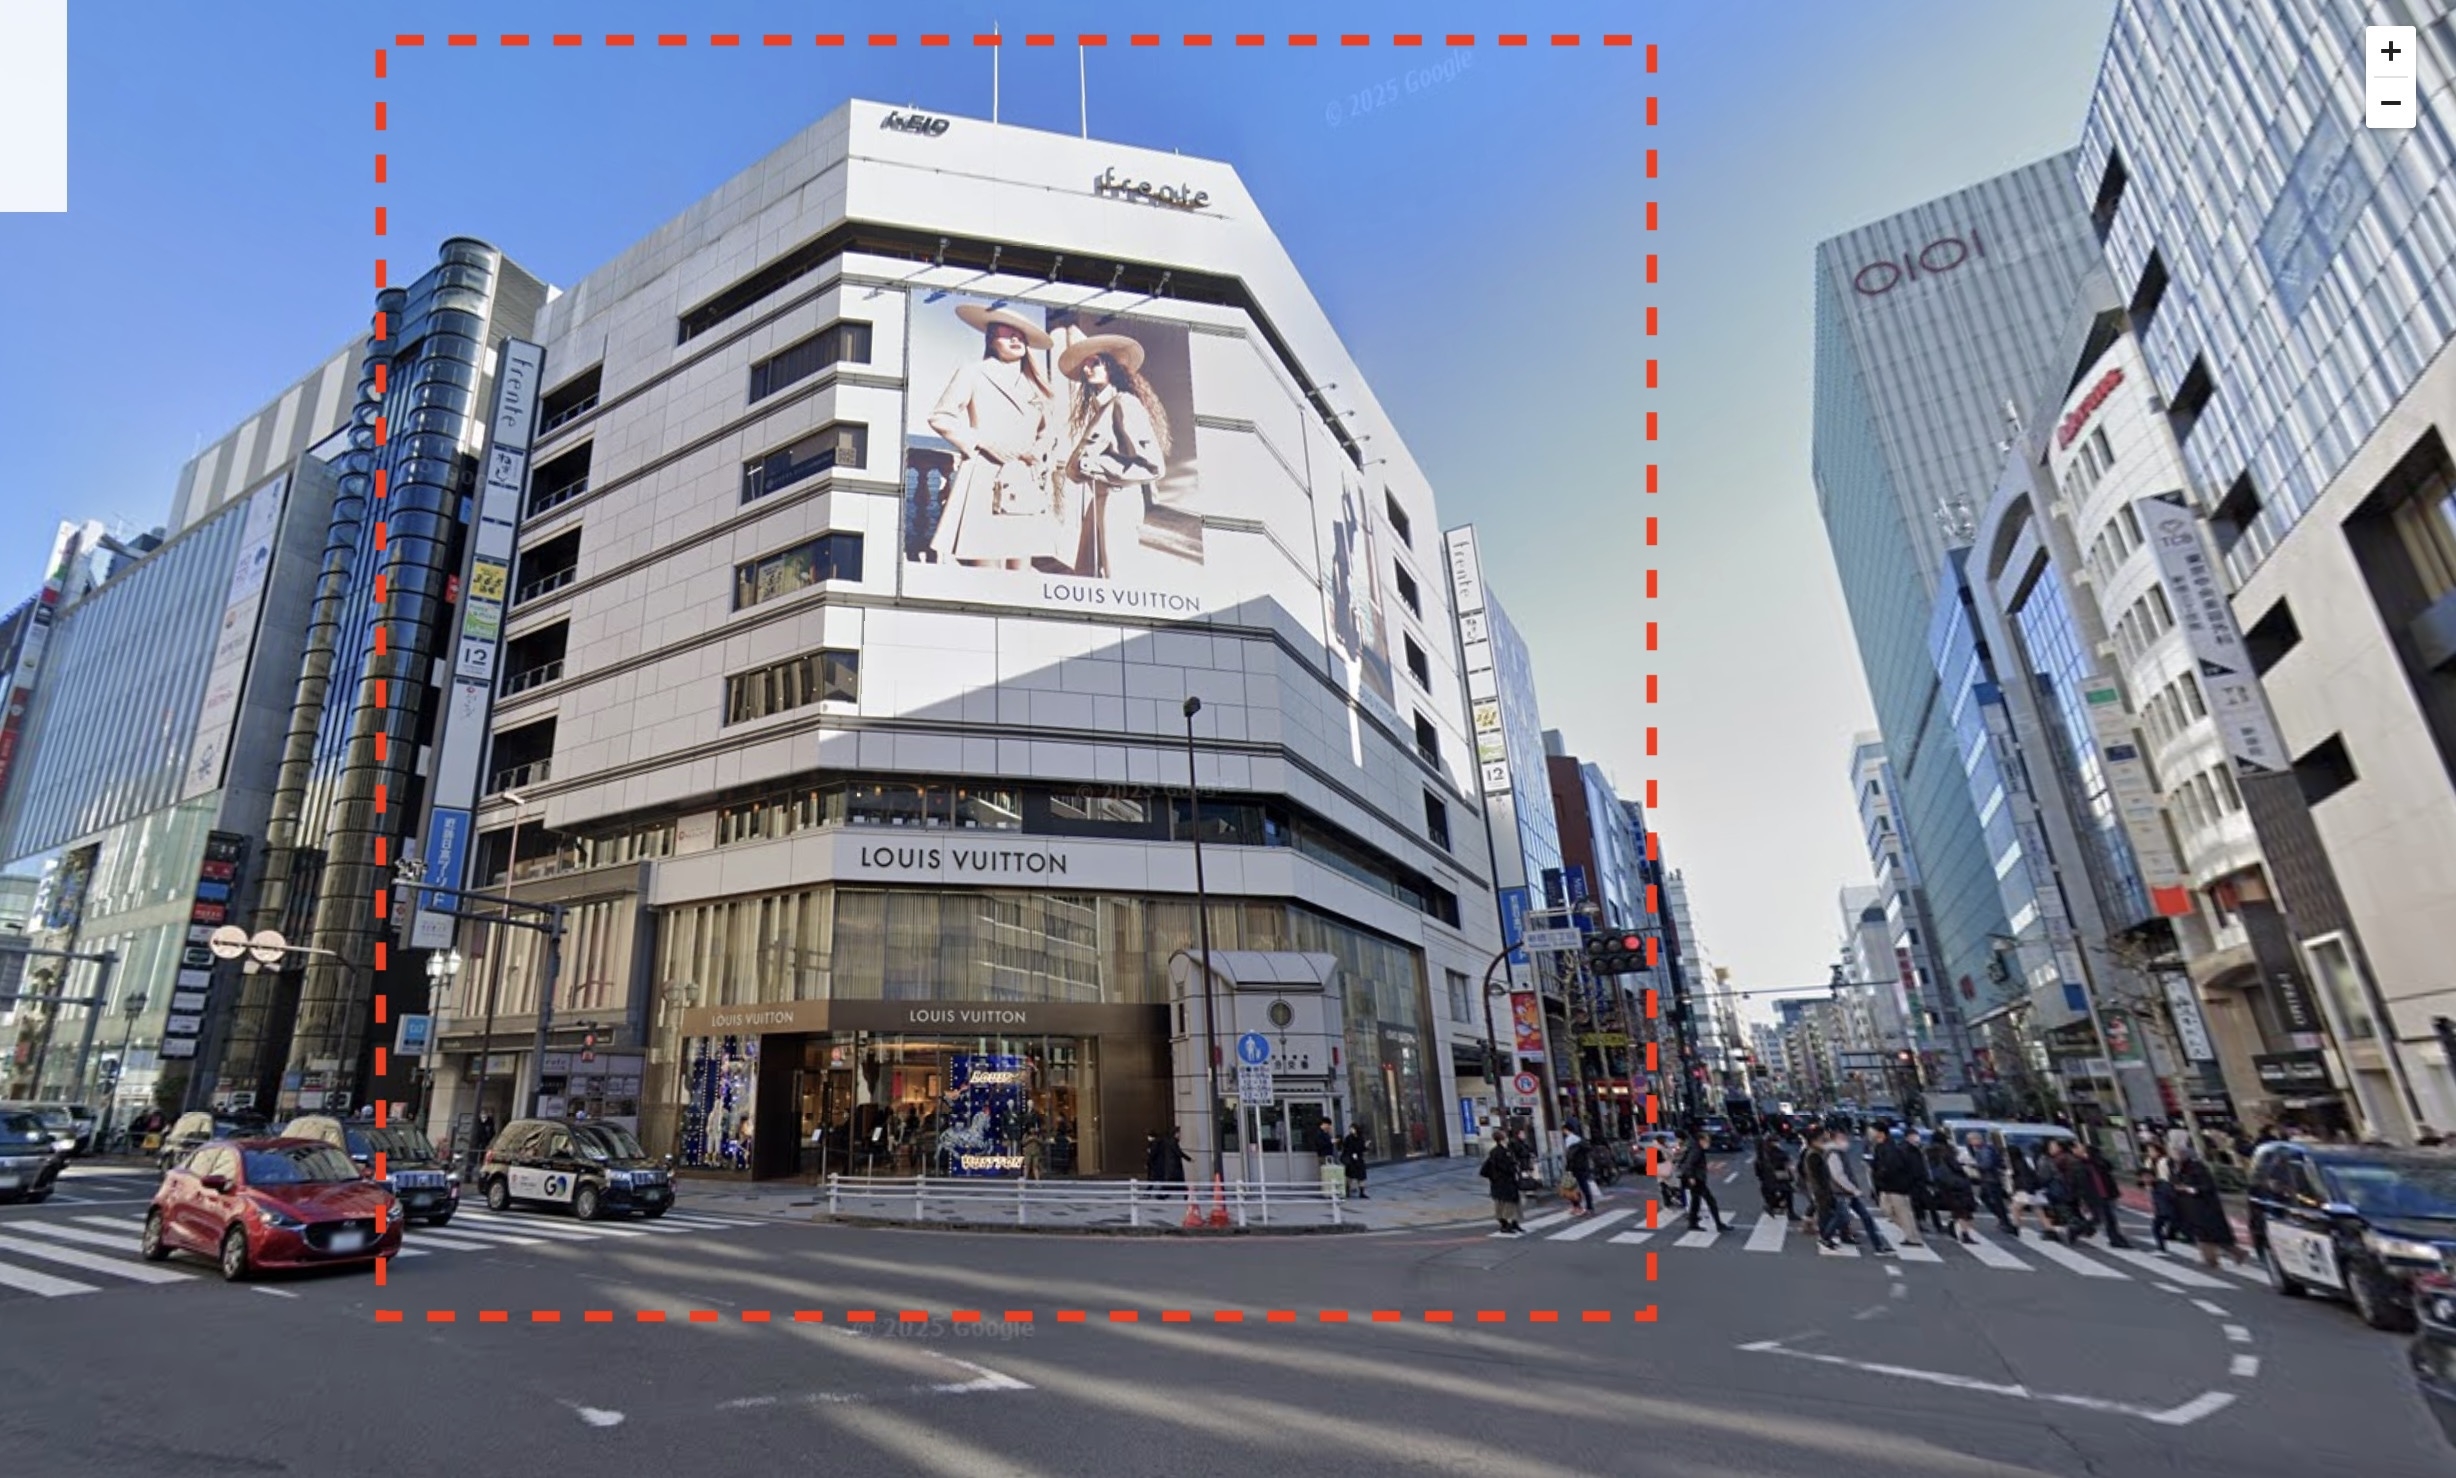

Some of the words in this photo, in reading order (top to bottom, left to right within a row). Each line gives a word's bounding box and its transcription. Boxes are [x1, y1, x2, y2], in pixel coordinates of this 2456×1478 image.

[500, 356, 534, 428] frente
[1042, 583, 1106, 605] LOUIS
[1112, 589, 1202, 612] VUITTON
[464, 647, 488, 666] 12
[1486, 767, 1505, 782] 12
[861, 846, 941, 869] LOUIS
[951, 849, 1067, 874] VUITTON
[711, 1013, 743, 1027] LOUIS
[745, 1011, 794, 1026] VUITTON
[909, 1009, 956, 1024] LOUIS
[960, 1009, 1027, 1025] VUITTON
